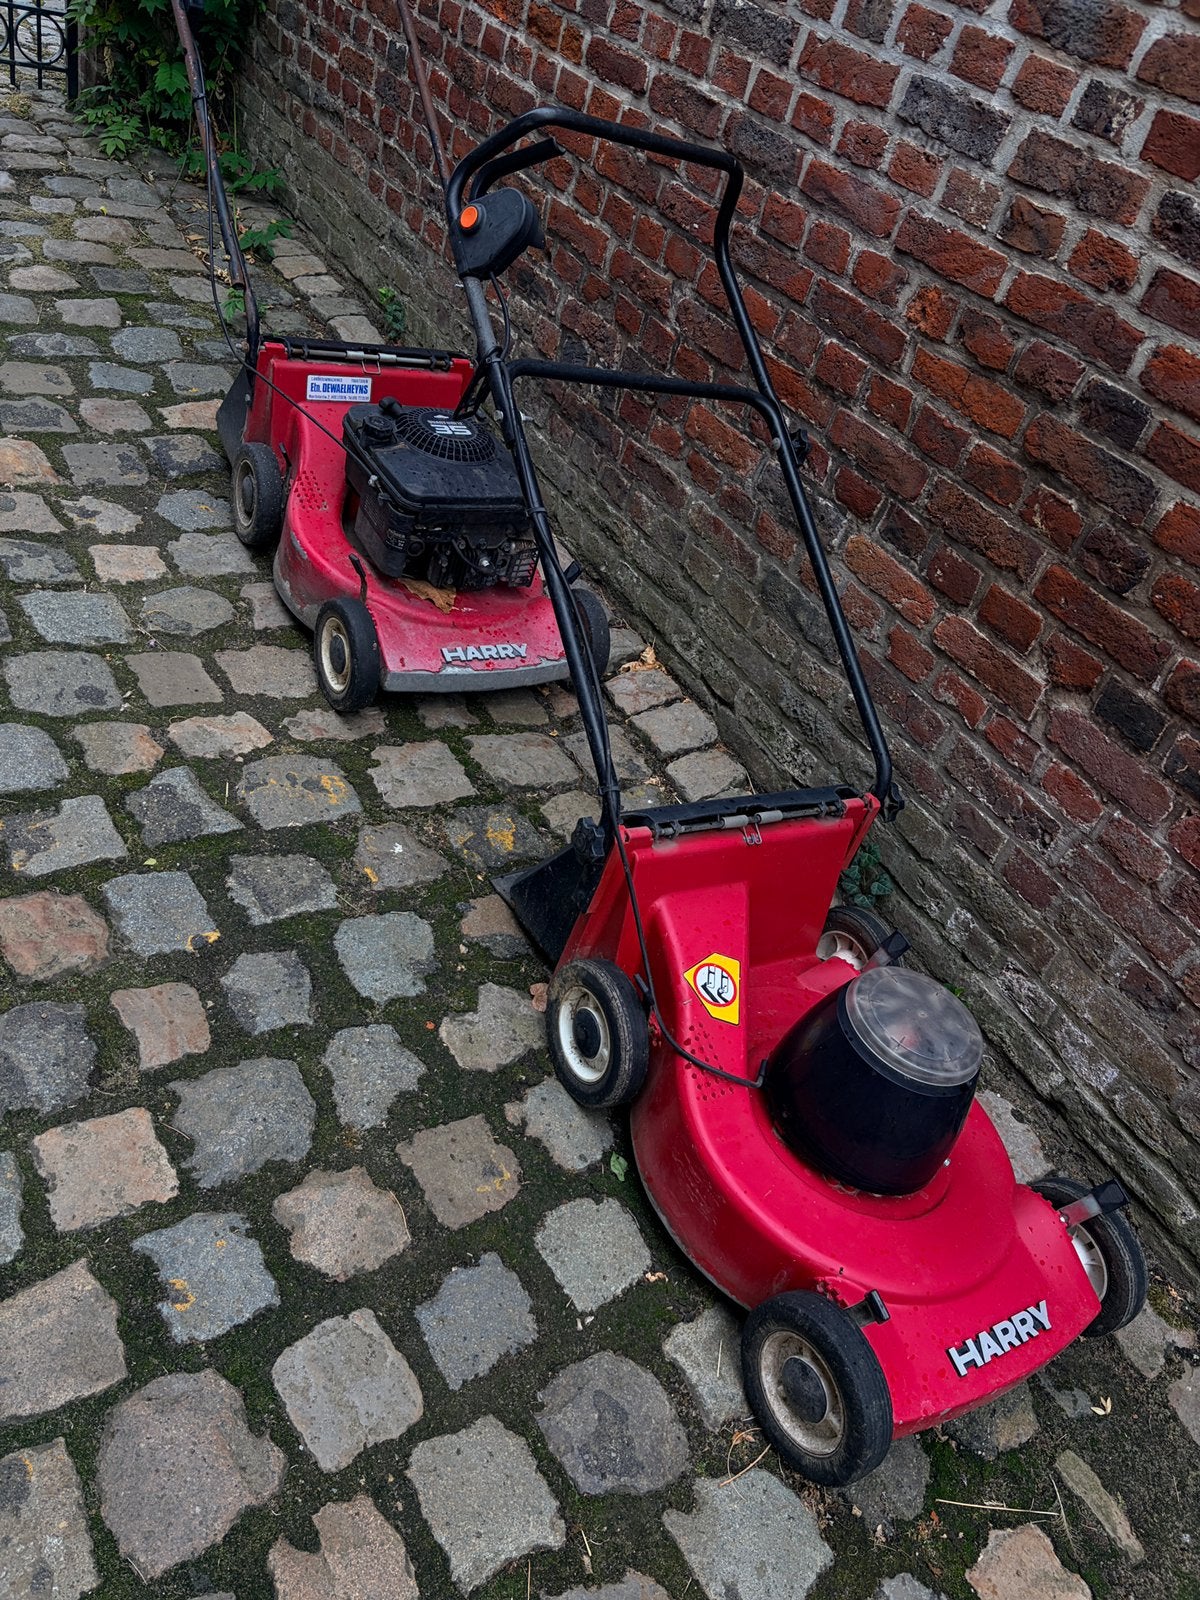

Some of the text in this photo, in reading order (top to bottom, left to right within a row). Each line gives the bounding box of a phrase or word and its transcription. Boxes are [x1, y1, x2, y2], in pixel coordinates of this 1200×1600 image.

[322, 383, 369, 395] DEWAELHEYNS
[430, 424, 472, 435] 35
[441, 643, 527, 663] HARRY
[946, 1299, 1052, 1377] HARRY
